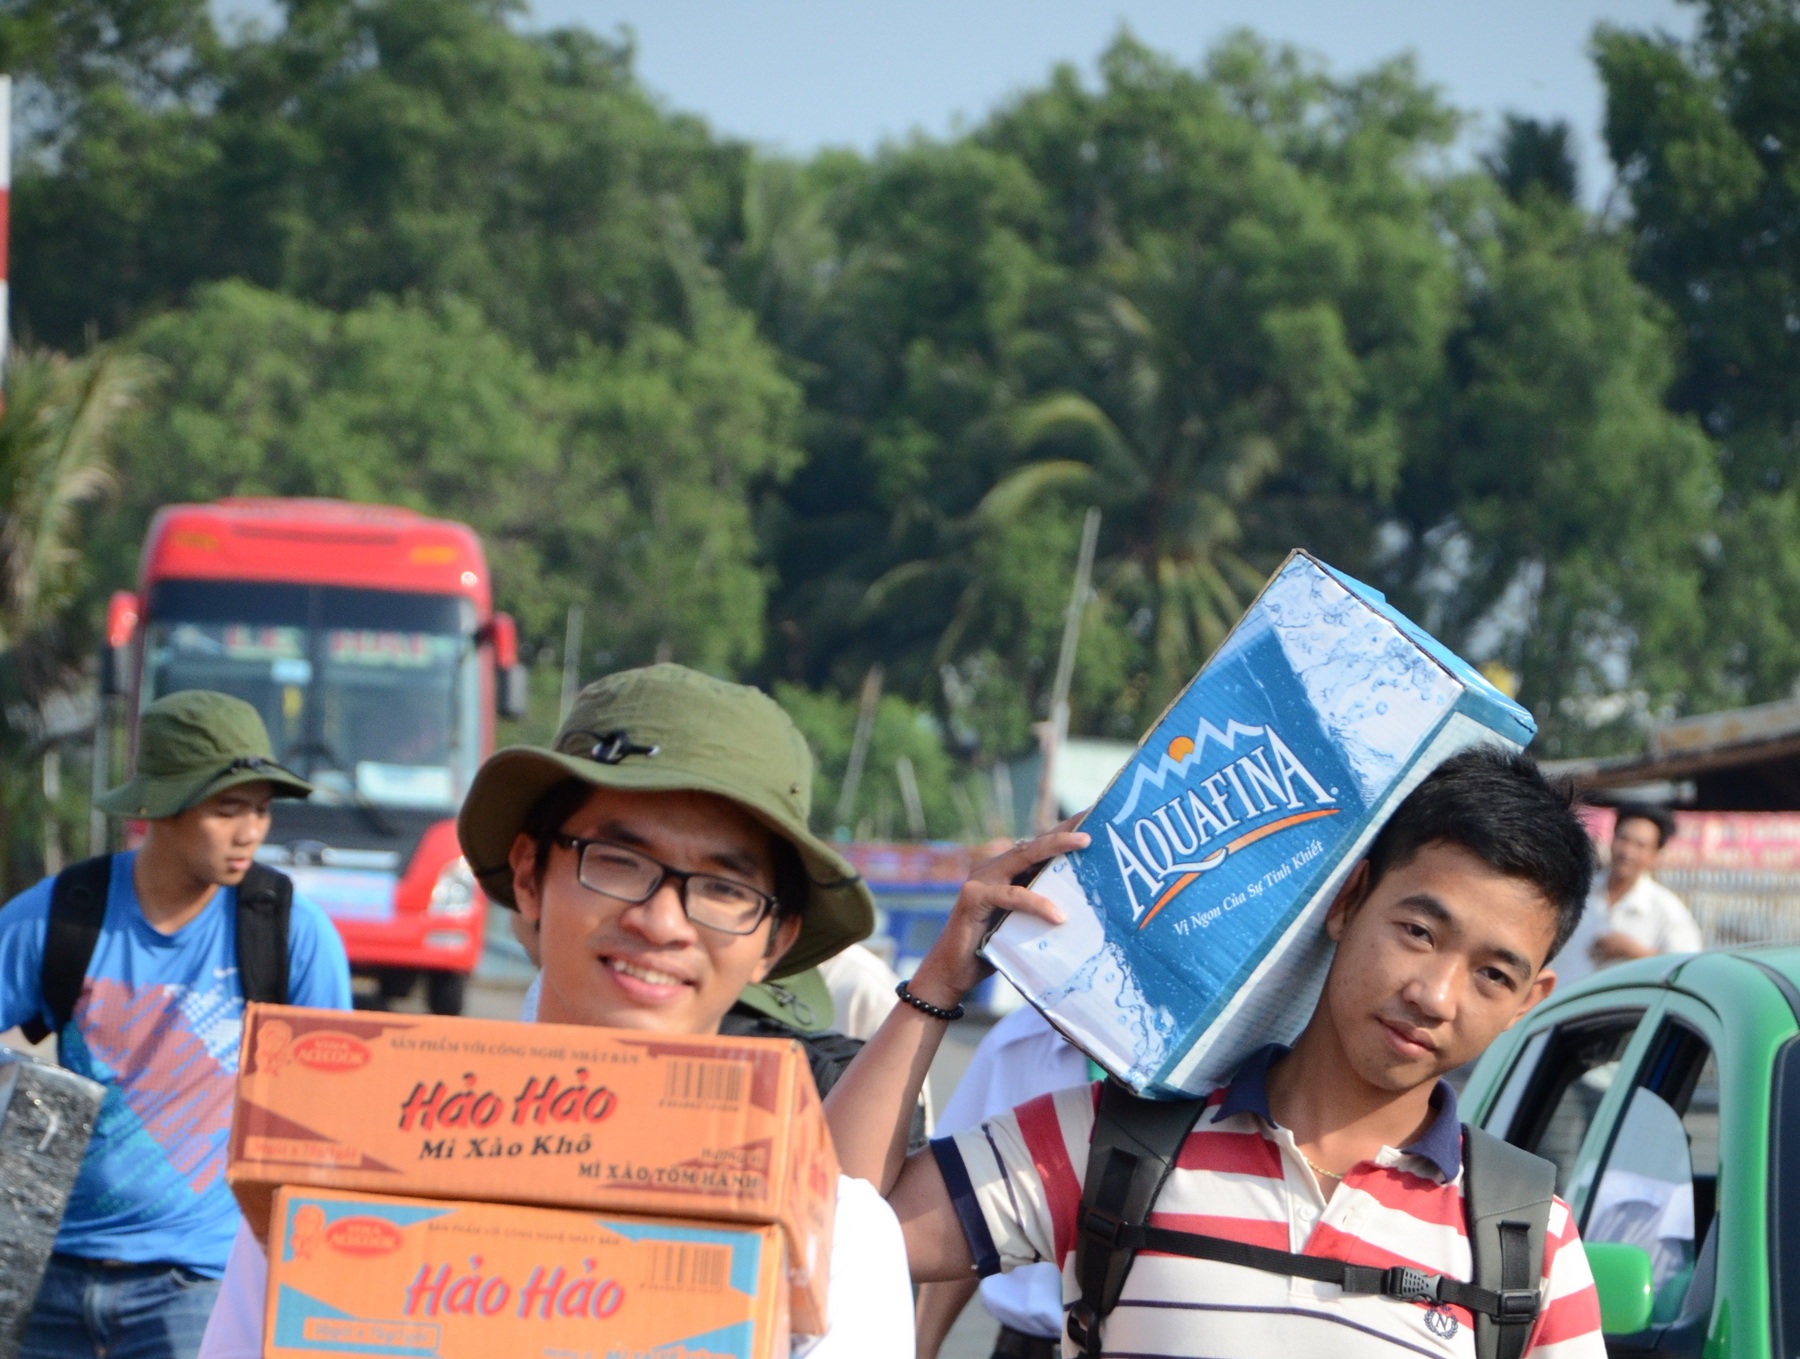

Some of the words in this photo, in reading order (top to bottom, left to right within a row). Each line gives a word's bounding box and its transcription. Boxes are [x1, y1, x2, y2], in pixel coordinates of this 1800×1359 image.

[1105, 723, 1336, 922] AQUAFINA
[1173, 921, 1190, 935] Vị
[1190, 903, 1221, 928] Ngon
[1222, 891, 1247, 911] Của
[1247, 879, 1264, 896] Sự
[1263, 865, 1291, 886] Tinh
[1291, 838, 1324, 867] Khiết
[399, 1072, 504, 1132] Hảo
[511, 1067, 618, 1126] Hảo
[464, 1136, 523, 1160] Xào
[531, 1134, 592, 1157] Khô
[402, 1254, 511, 1317] Hảo
[516, 1257, 625, 1319] Hảo
